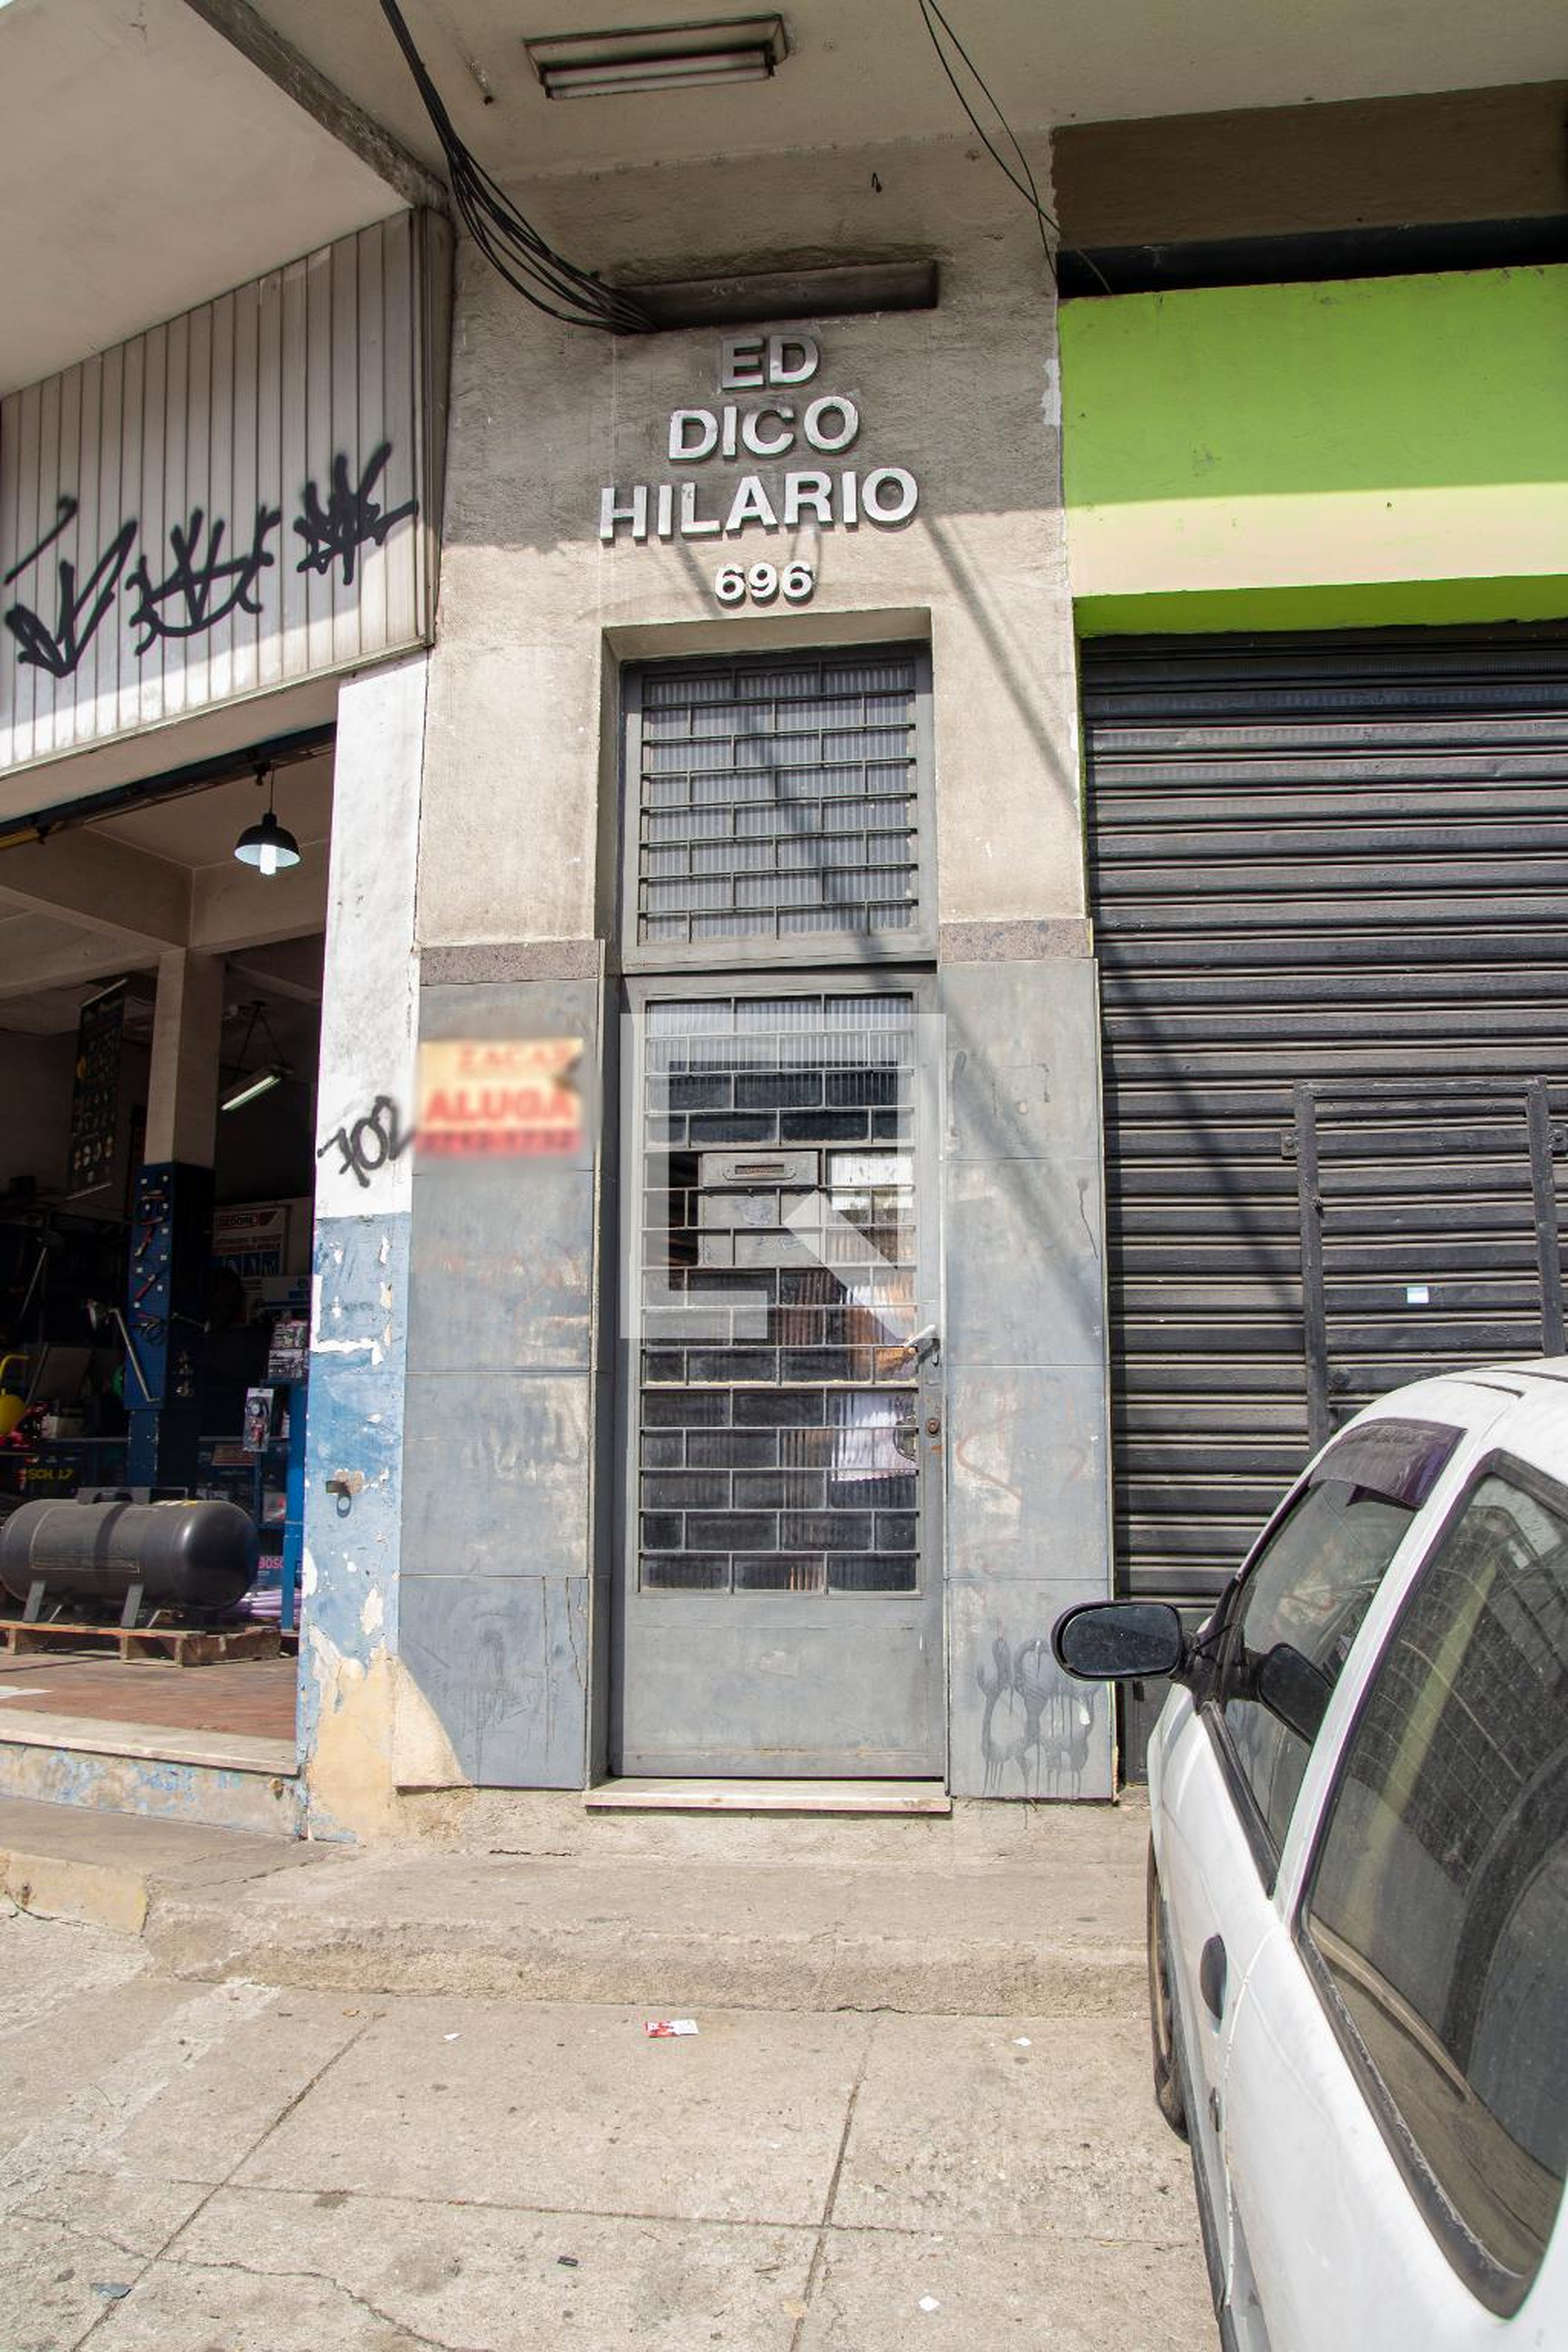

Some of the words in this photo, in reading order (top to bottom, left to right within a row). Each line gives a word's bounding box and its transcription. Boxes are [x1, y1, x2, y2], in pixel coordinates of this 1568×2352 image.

[722, 334, 819, 389] ED
[668, 395, 859, 462] DICO
[599, 467, 919, 541] HILARIO
[714, 560, 813, 604] 696
[257, 1555, 283, 1569] BOS
